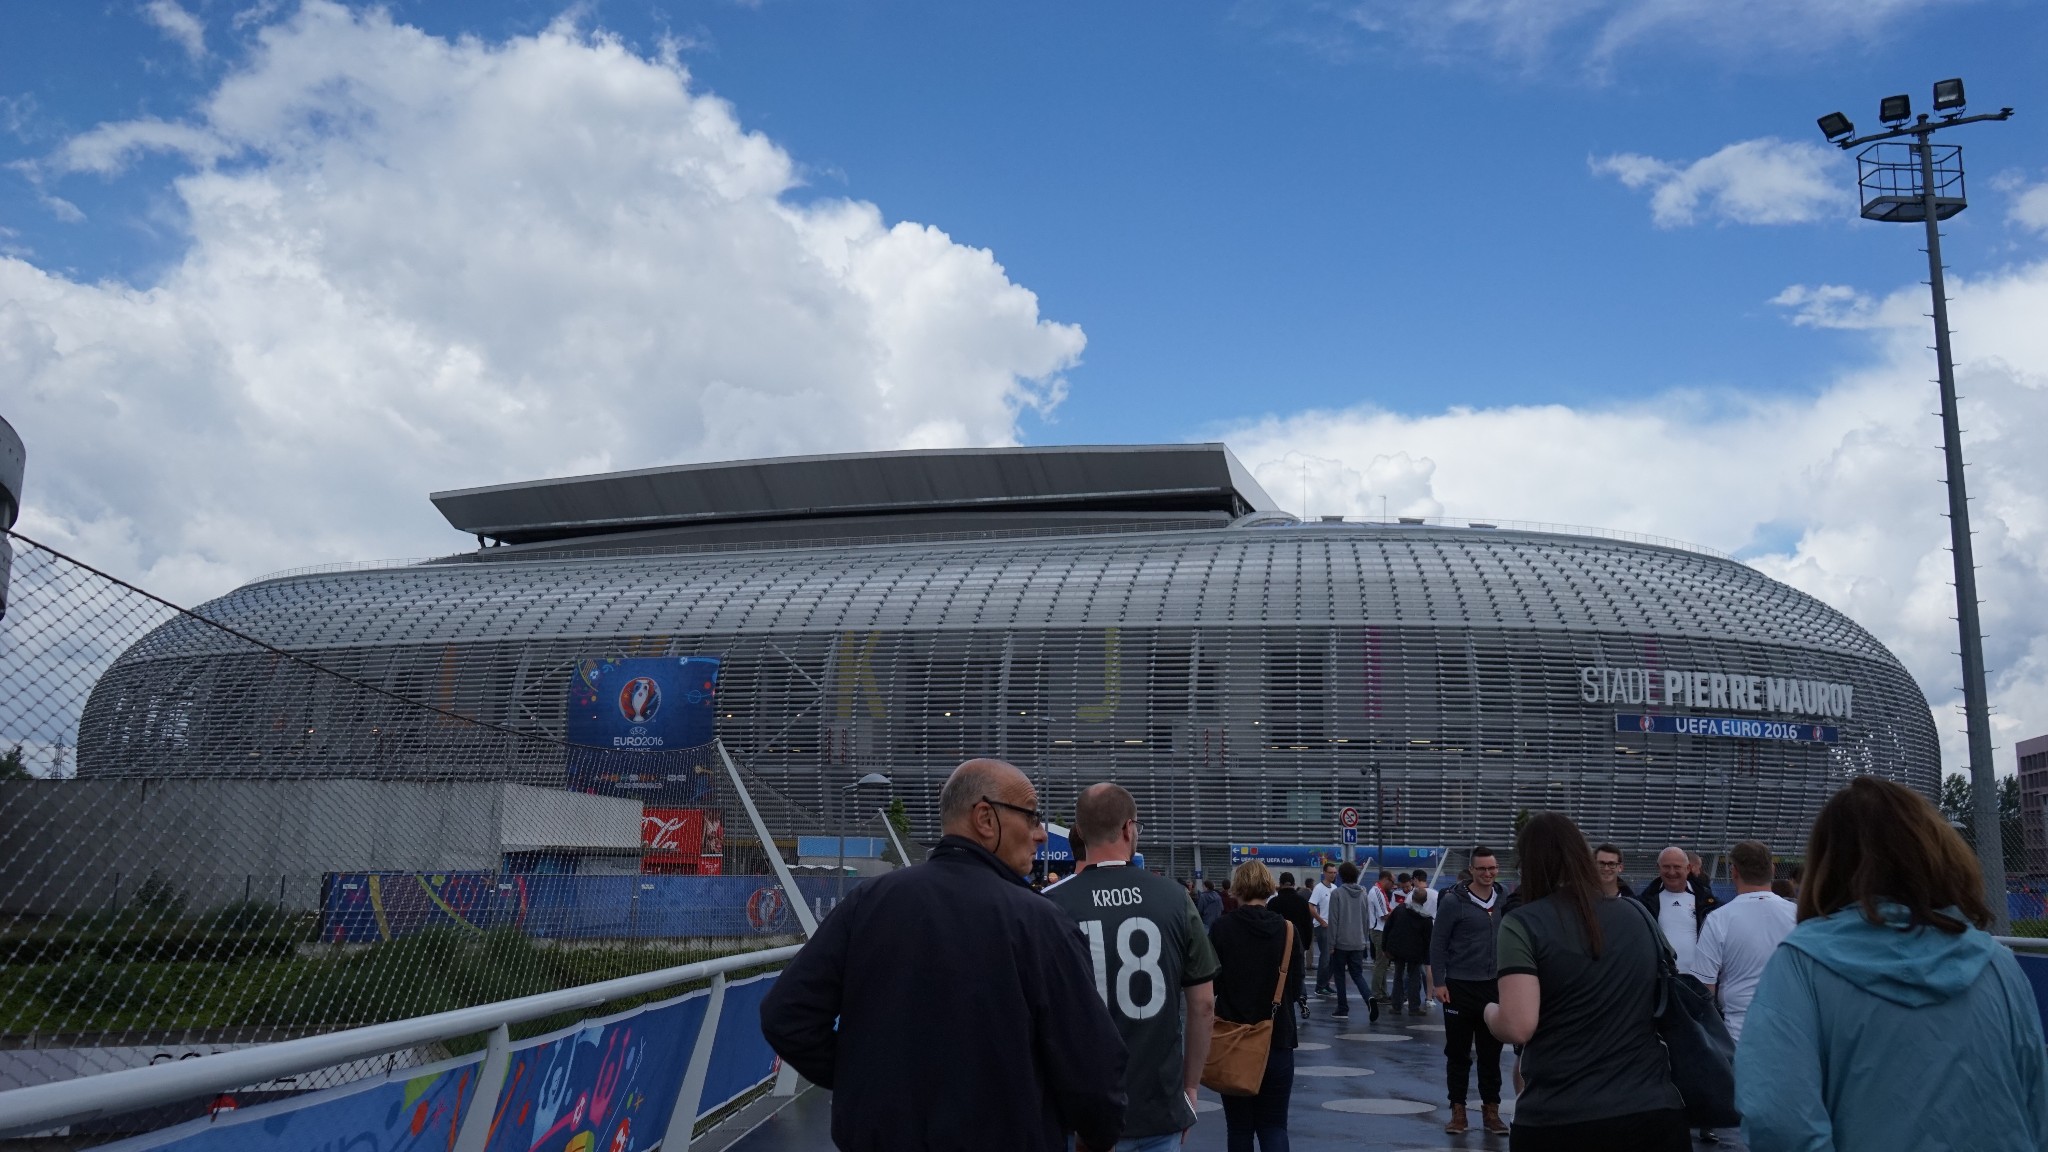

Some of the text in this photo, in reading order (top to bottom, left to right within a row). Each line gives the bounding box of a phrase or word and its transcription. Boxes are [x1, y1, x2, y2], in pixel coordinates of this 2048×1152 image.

[1581, 666, 1854, 719] STADE PIERRE MAUROY
[1676, 717, 1798, 739] UEFA EURO 2016
[613, 736, 664, 746] EURO2016
[1041, 851, 1069, 861] SHOP
[1092, 886, 1143, 907] KROOS
[1079, 916, 1167, 1020] 18
